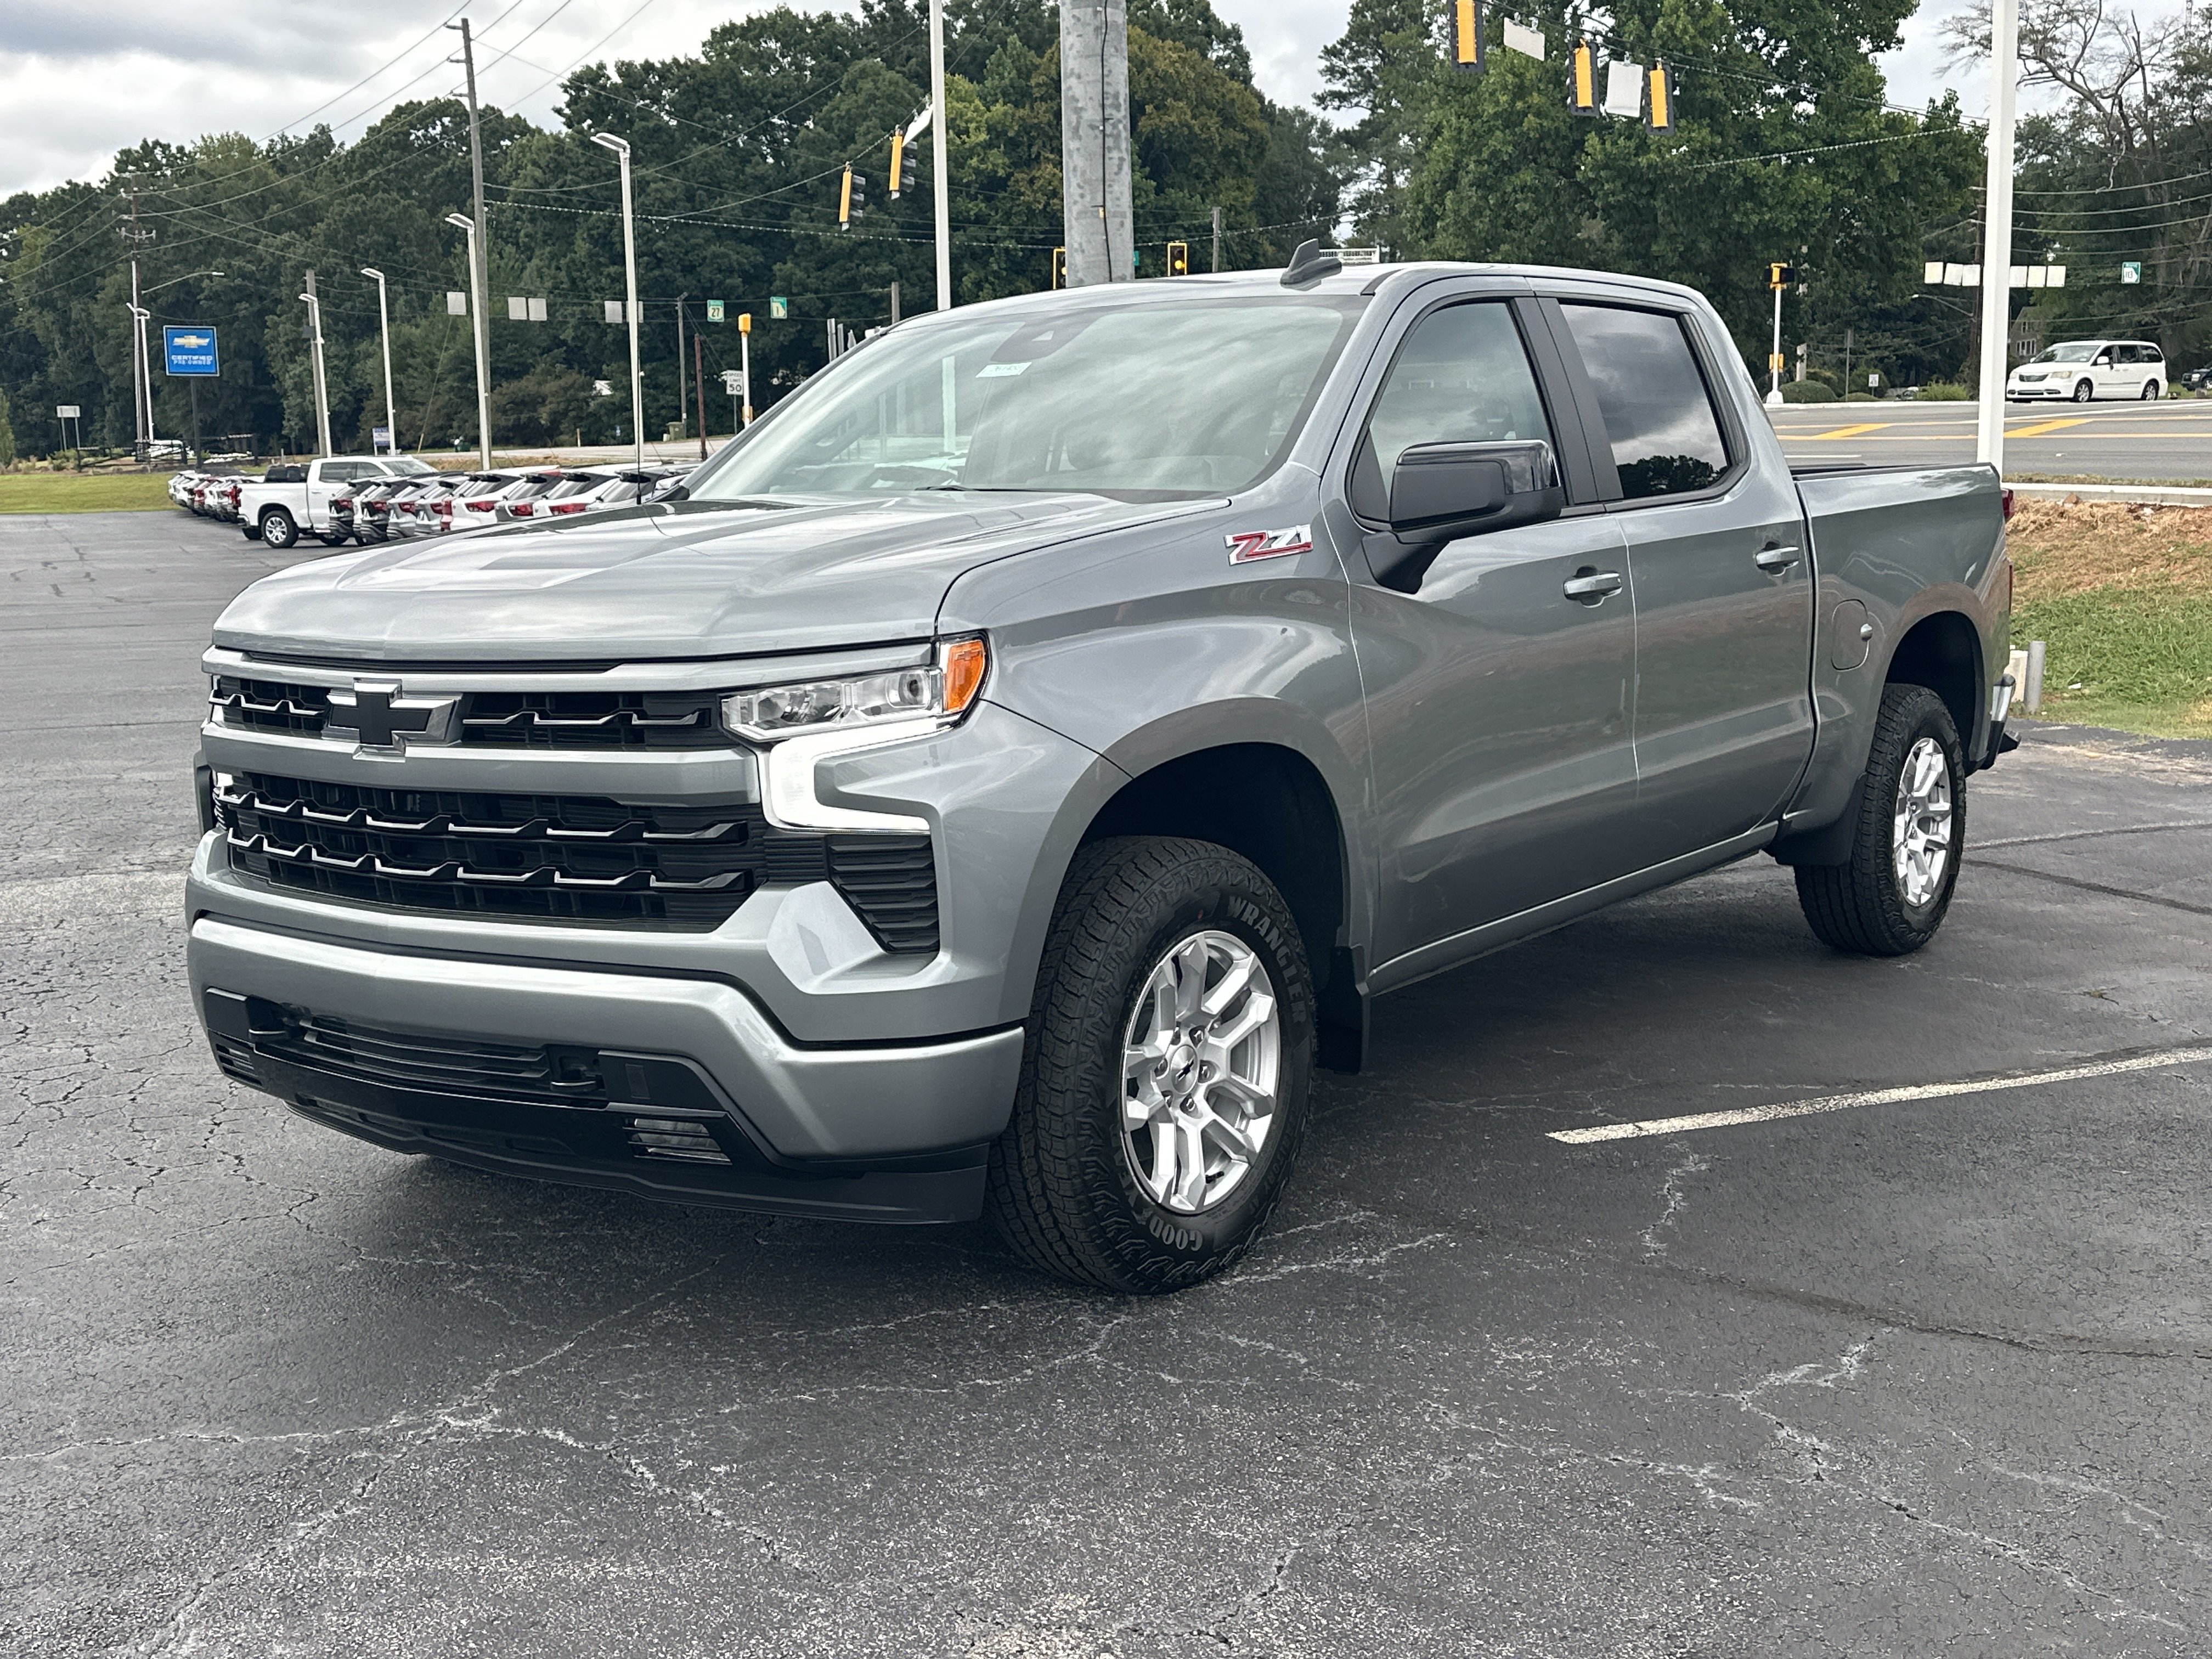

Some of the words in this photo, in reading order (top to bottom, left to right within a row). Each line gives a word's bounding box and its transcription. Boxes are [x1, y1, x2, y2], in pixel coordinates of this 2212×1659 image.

[711, 308, 720, 318] 27
[729, 383, 742, 392] 50
[1225, 524, 1313, 566] Z71
[1227, 895, 1307, 1024] WRANGLER
